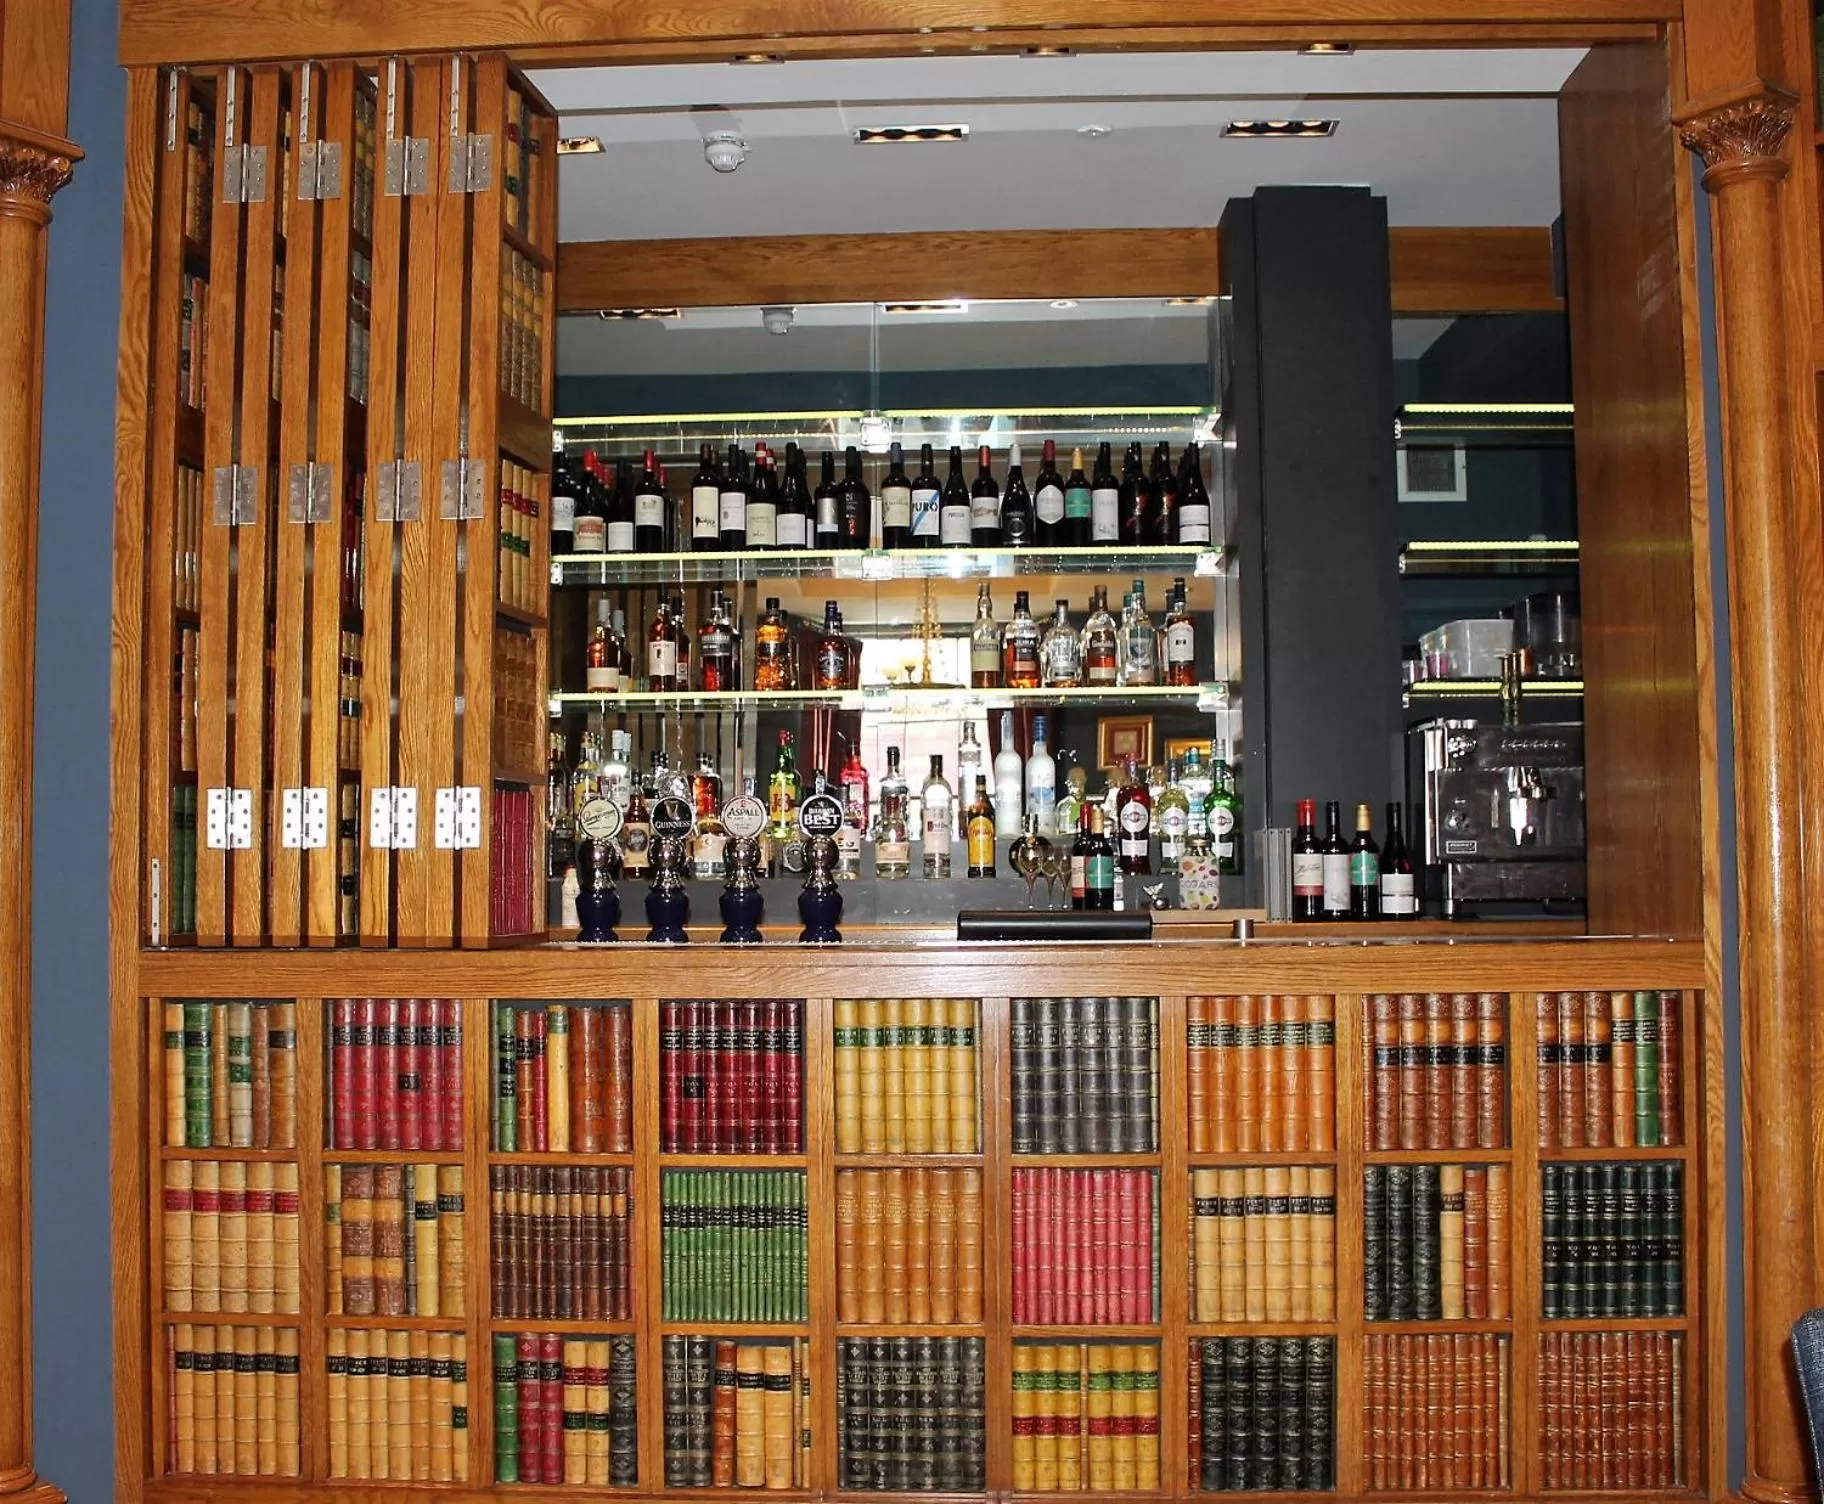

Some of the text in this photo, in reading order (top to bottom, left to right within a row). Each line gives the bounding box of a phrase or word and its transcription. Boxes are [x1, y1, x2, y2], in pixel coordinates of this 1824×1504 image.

[727, 807, 760, 818] ASPALL
[655, 820, 691, 829] GUINNESS
[804, 814, 840, 825] BEST
